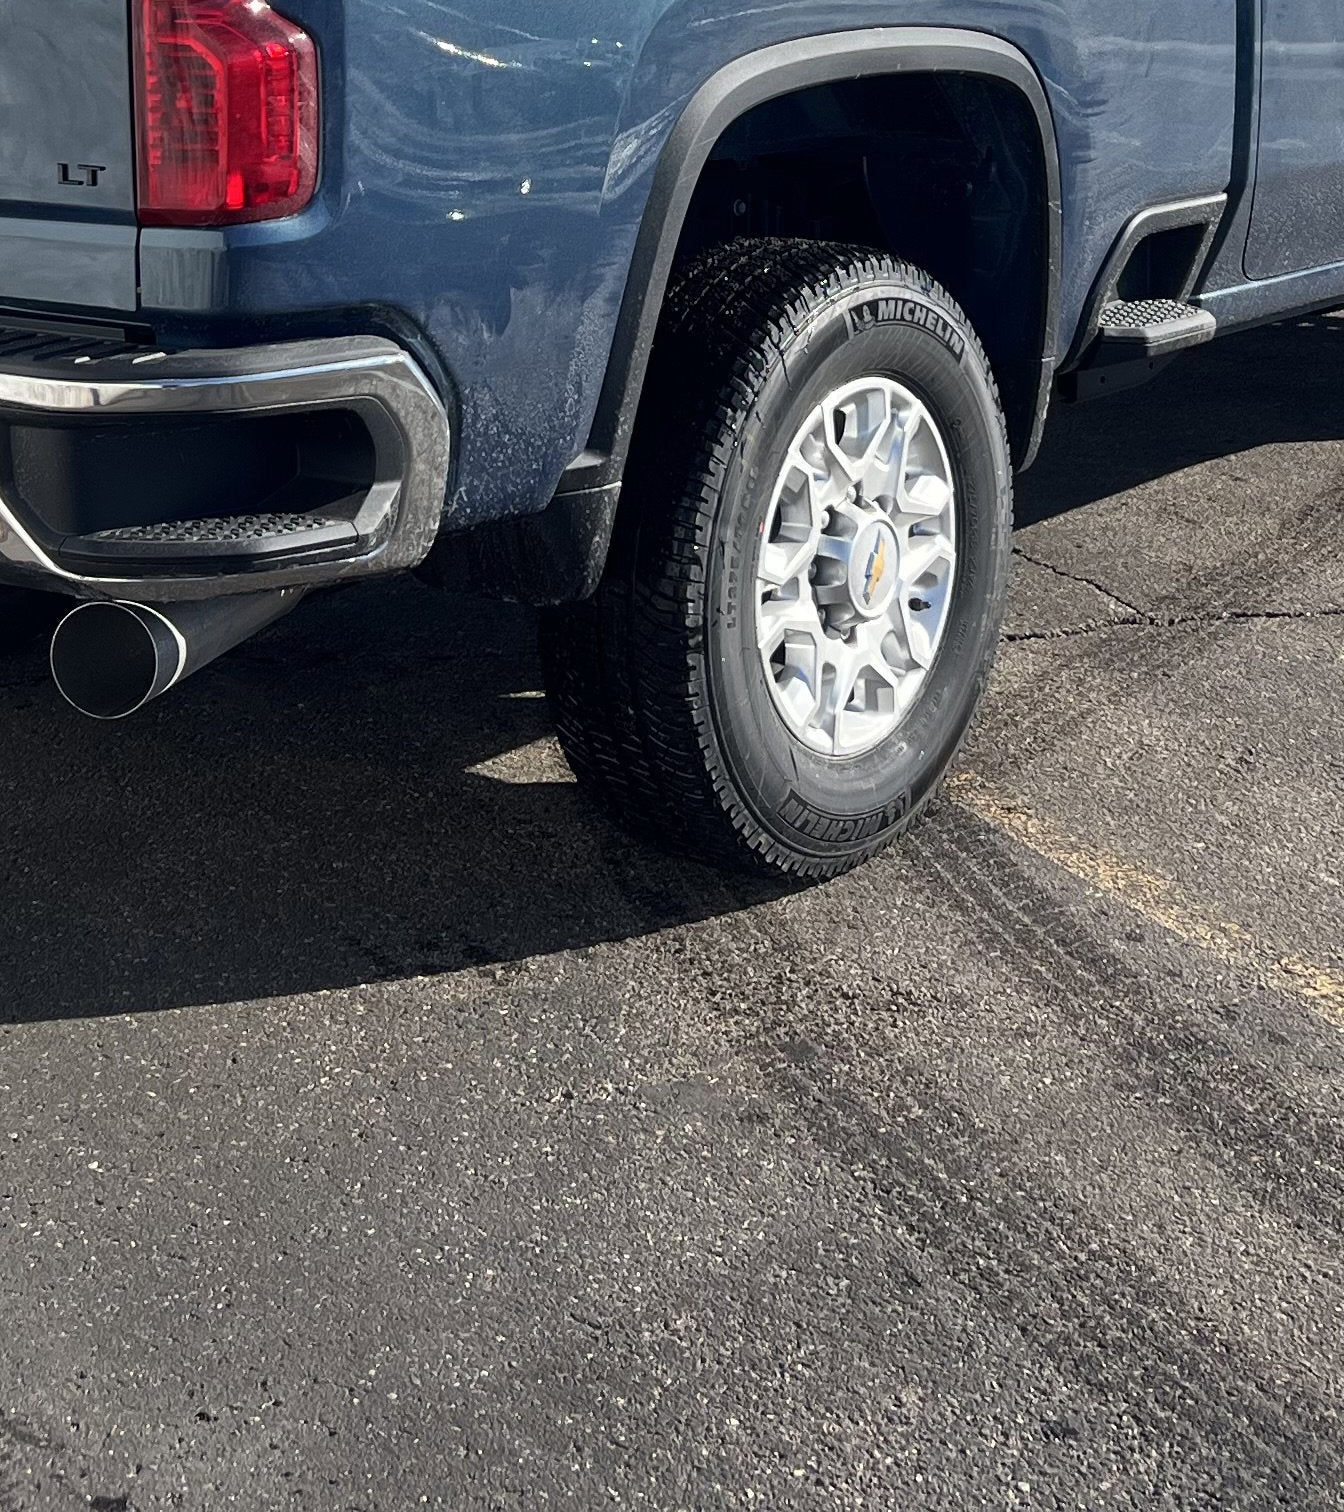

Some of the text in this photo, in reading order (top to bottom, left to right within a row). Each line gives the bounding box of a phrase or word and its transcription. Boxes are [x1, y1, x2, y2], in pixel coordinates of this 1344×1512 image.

[57, 162, 106, 187] LT
[877, 299, 966, 356] MICHELIN
[779, 797, 884, 842] MICHELIN
